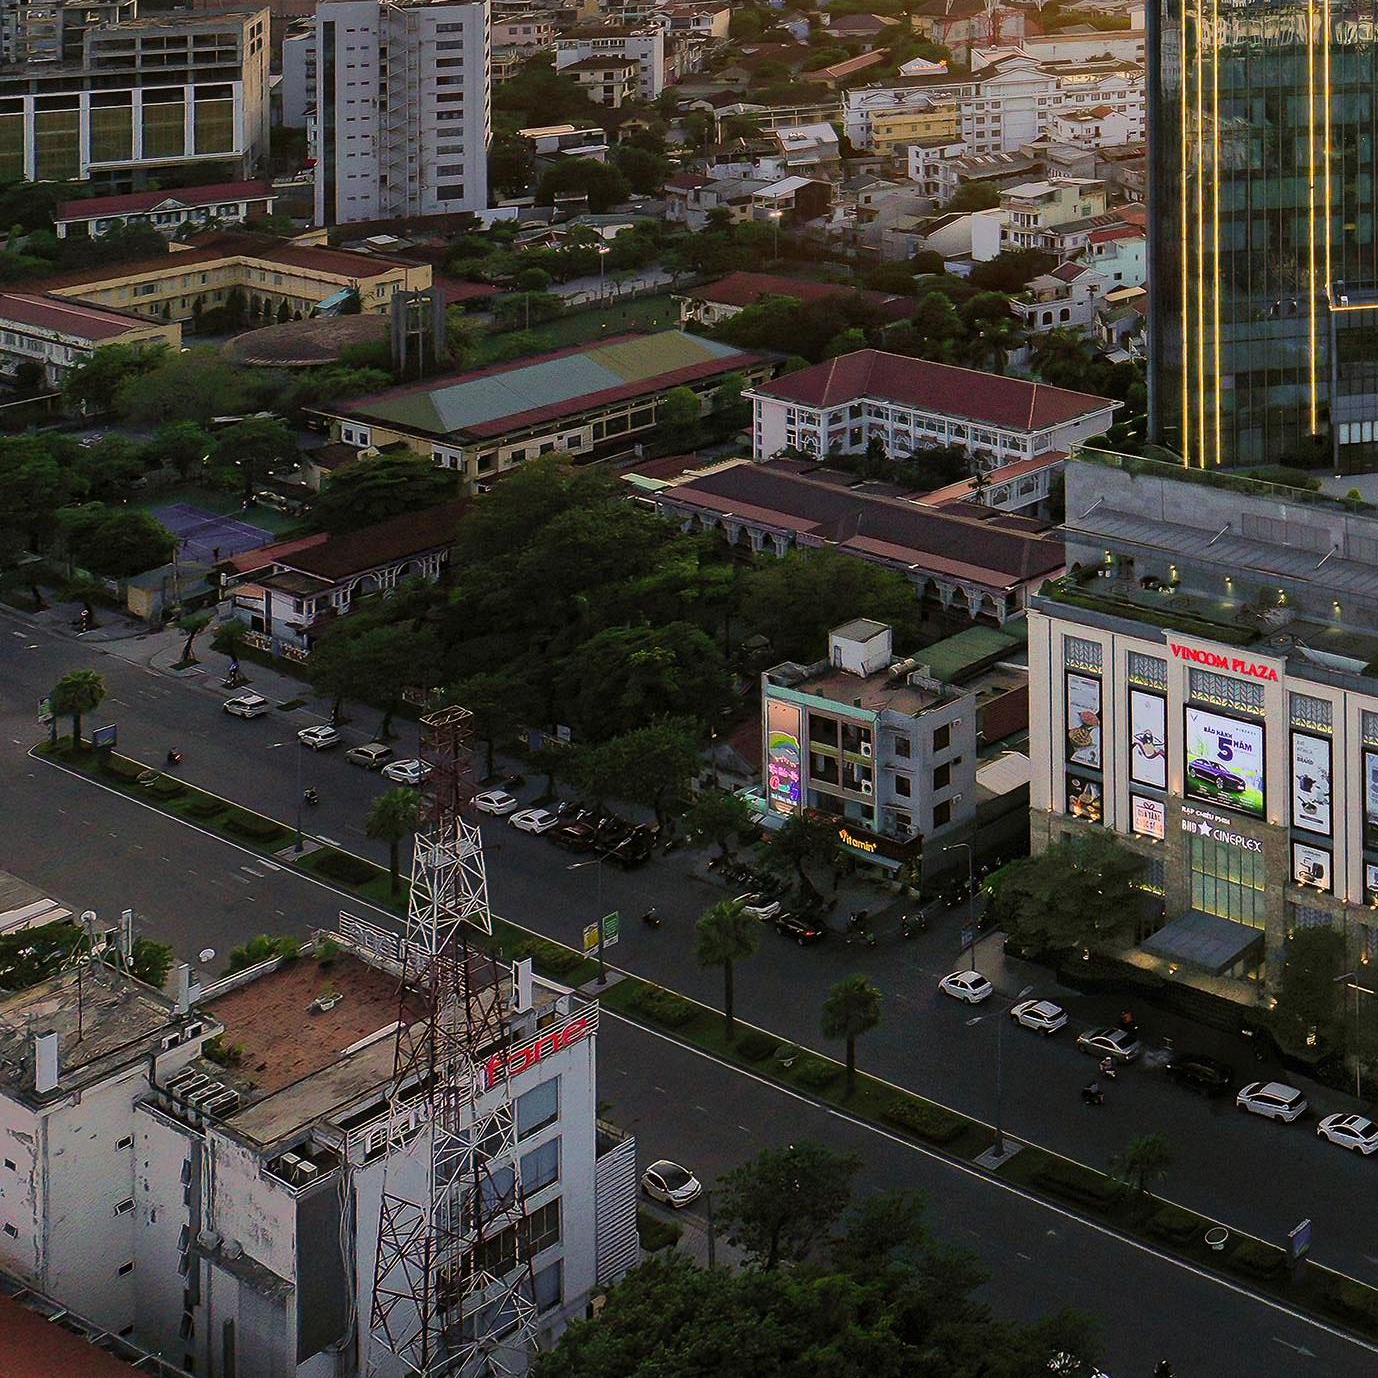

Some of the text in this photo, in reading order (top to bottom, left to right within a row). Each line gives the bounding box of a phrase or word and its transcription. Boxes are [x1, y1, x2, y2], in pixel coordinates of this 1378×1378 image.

[1170, 643, 1279, 682] VINCOM PLAZA
[1217, 736, 1234, 762] 5
[1213, 829, 1262, 853] CINEPLEX
